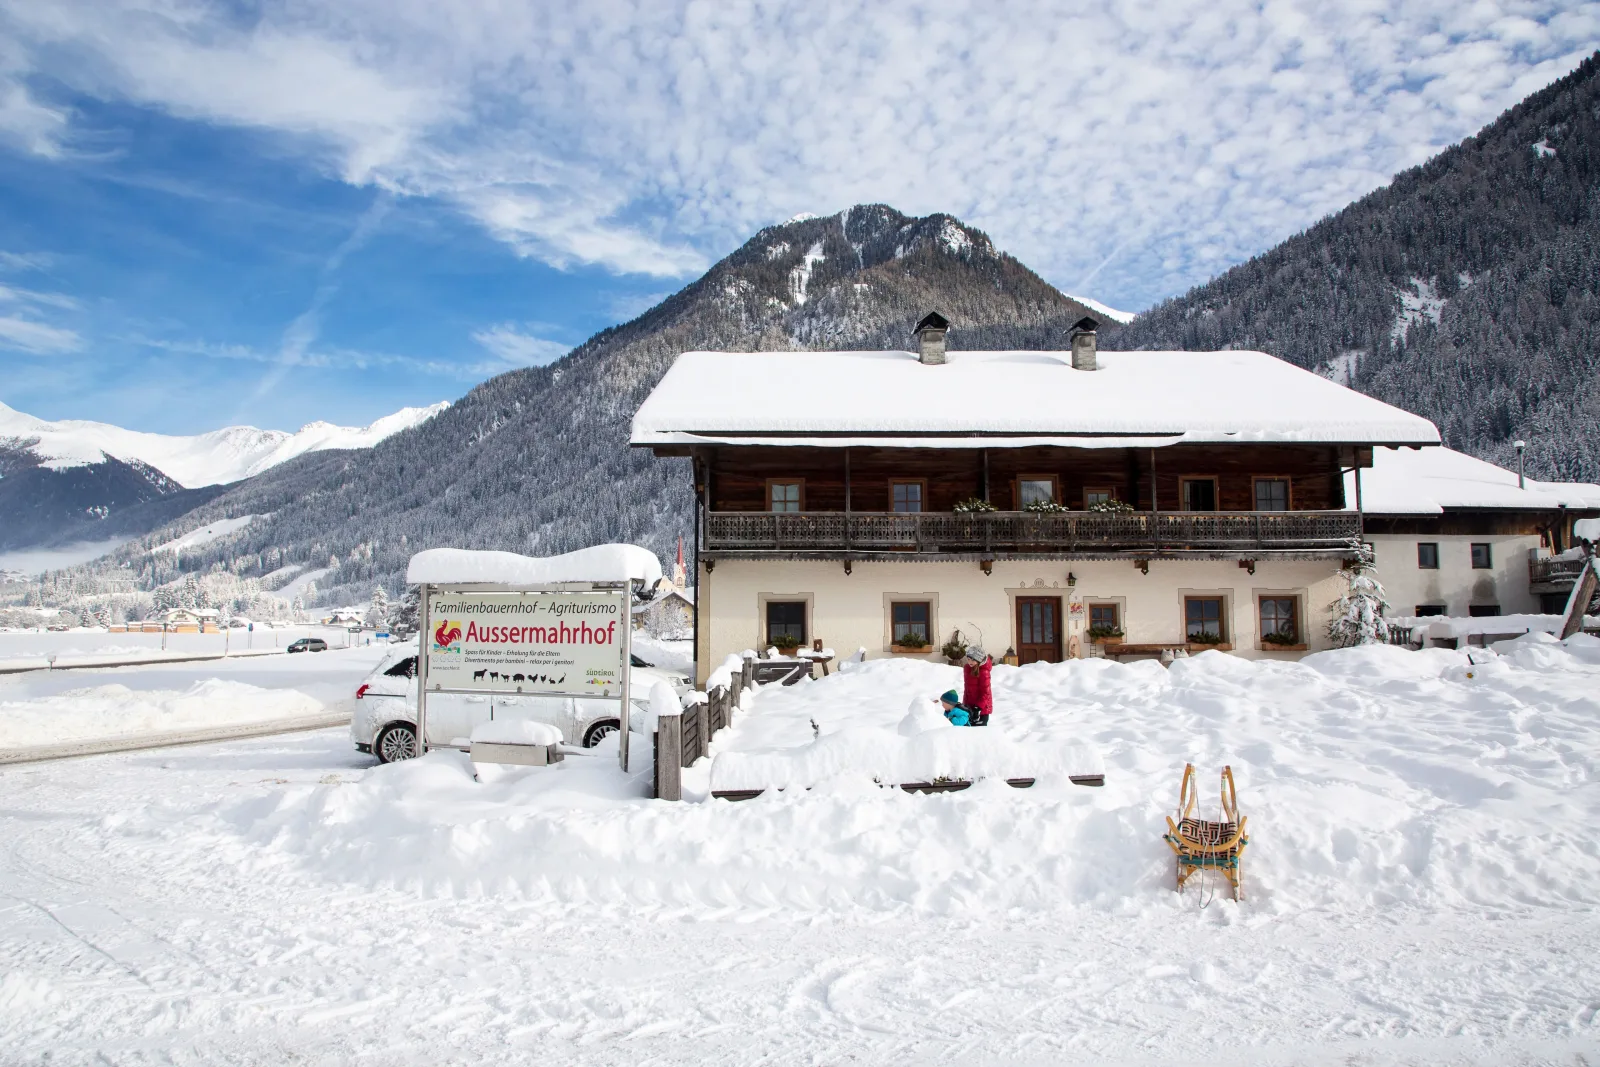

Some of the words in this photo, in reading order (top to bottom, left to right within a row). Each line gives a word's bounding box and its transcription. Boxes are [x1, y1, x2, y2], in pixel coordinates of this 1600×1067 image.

[434, 601, 538, 614] Familienbauernhof
[548, 601, 617, 617] Agriturismo
[465, 620, 616, 645] Aussermahrhof
[506, 650, 528, 658] Erholung
